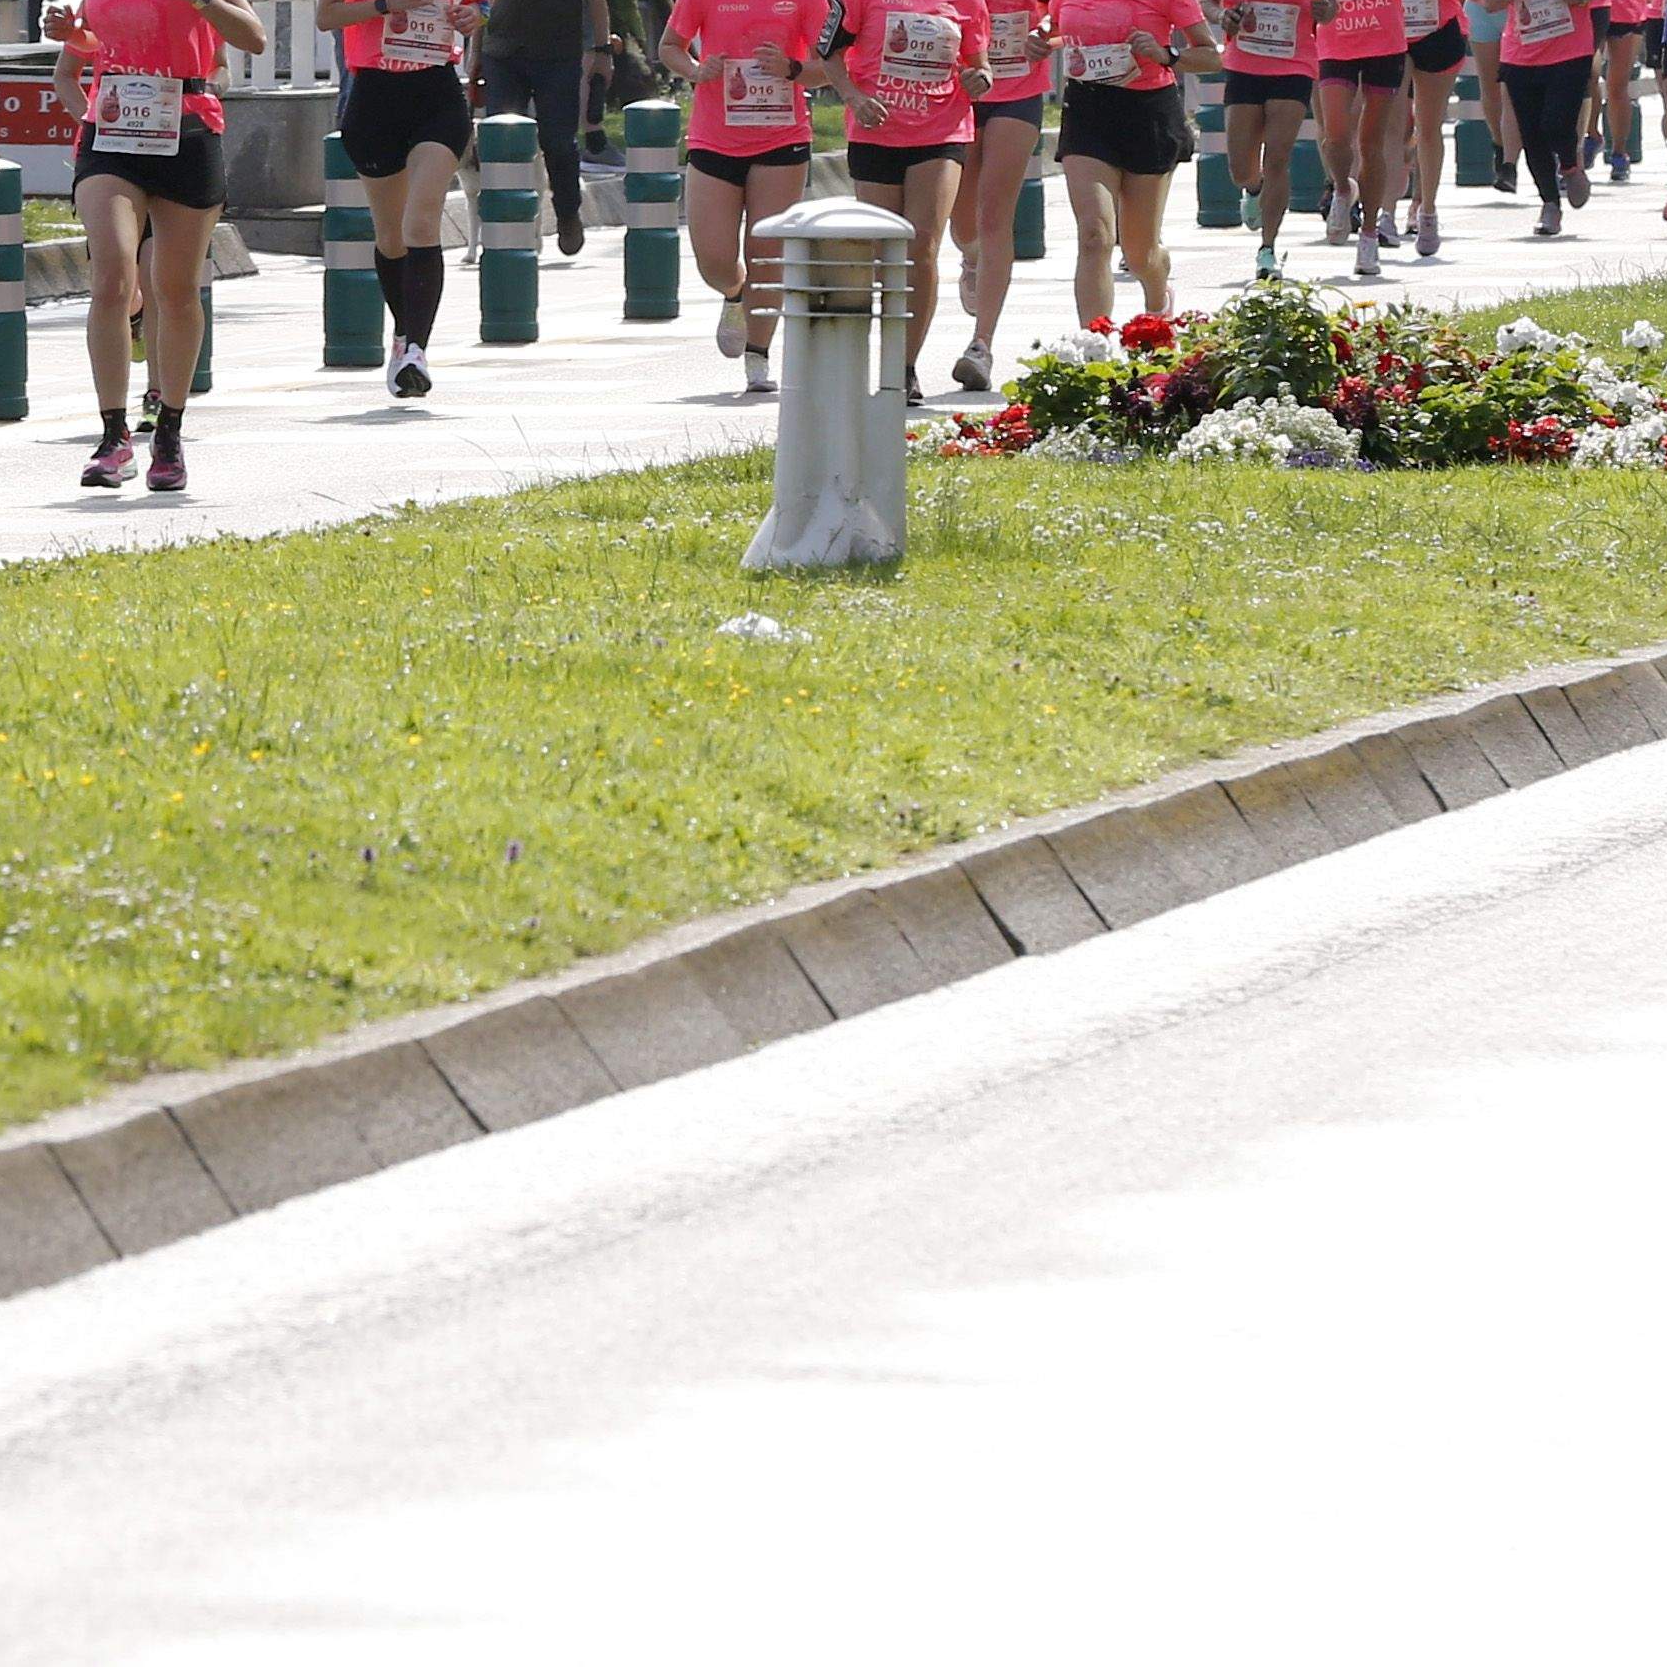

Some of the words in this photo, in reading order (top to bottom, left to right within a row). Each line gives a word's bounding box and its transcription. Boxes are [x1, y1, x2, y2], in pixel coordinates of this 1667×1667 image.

[410, 21, 435, 32] 016
[1258, 23, 1279, 32] 016
[1336, 15, 1380, 31] SUMA
[910, 39, 935, 51] 016
[1088, 57, 1113, 69] 016
[749, 85, 774, 95] 016
[38, 90, 70, 113] P
[122, 106, 151, 118] 016
[48, 125, 72, 138] du
